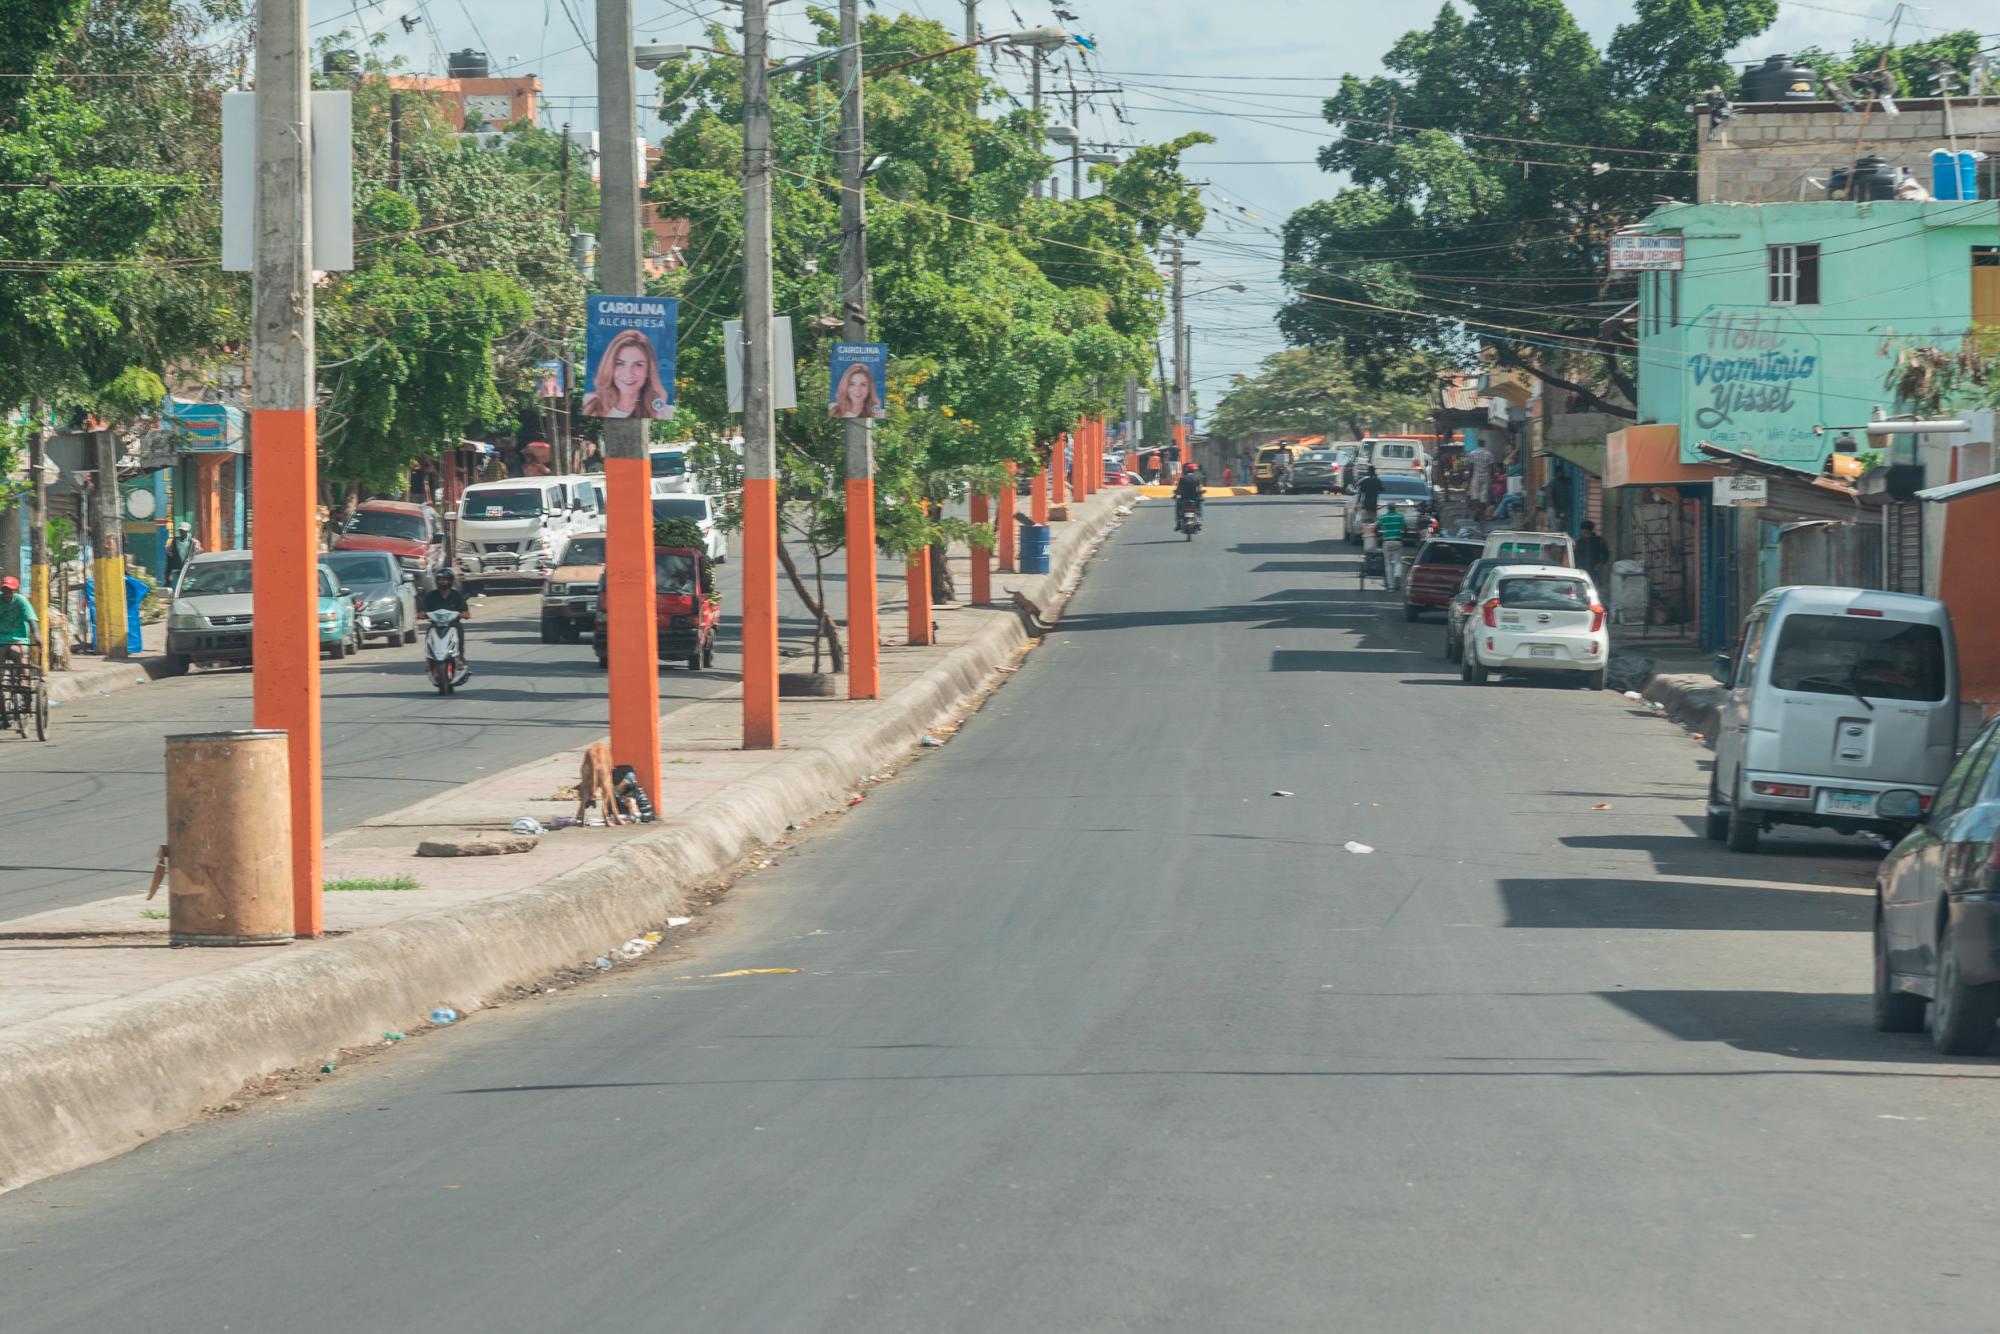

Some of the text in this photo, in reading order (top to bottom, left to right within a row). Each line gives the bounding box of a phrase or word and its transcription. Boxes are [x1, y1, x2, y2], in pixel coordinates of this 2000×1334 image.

[1612, 237, 1636, 249] HOTEL
[598, 302, 666, 315] CAROLINA
[598, 317, 666, 328] ALCALDESA
[1705, 311, 1786, 350] Hotel
[837, 346, 880, 354] CAROLINA
[1687, 349, 1817, 386] Dormitorio
[1695, 380, 1796, 429] Yissel
